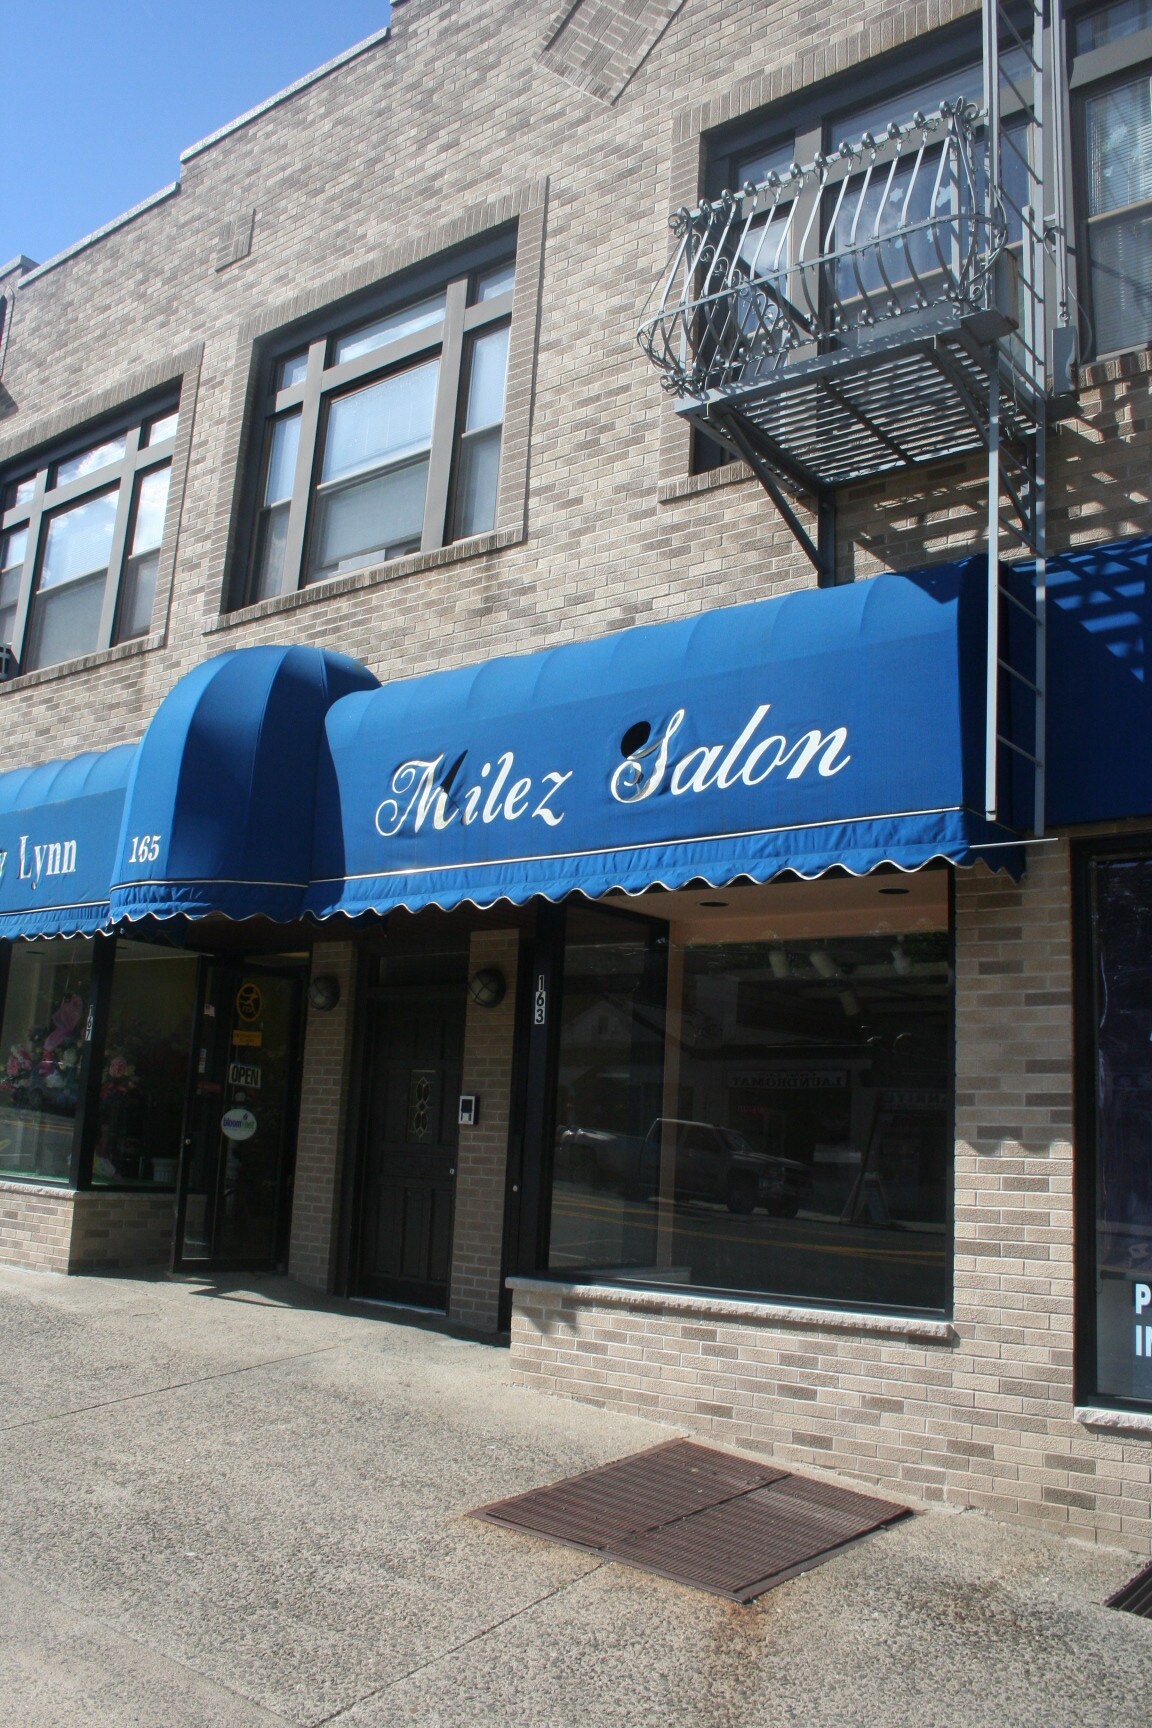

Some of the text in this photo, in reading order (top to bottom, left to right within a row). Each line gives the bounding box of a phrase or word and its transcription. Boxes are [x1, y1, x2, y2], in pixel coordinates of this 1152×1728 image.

[375, 704, 851, 837] Milez Salon
[18, 835, 77, 890] Lynn
[129, 835, 162, 863] 165
[535, 975, 546, 1025] 163
[85, 1005, 95, 1041] 167
[231, 1065, 259, 1086] OPEN
